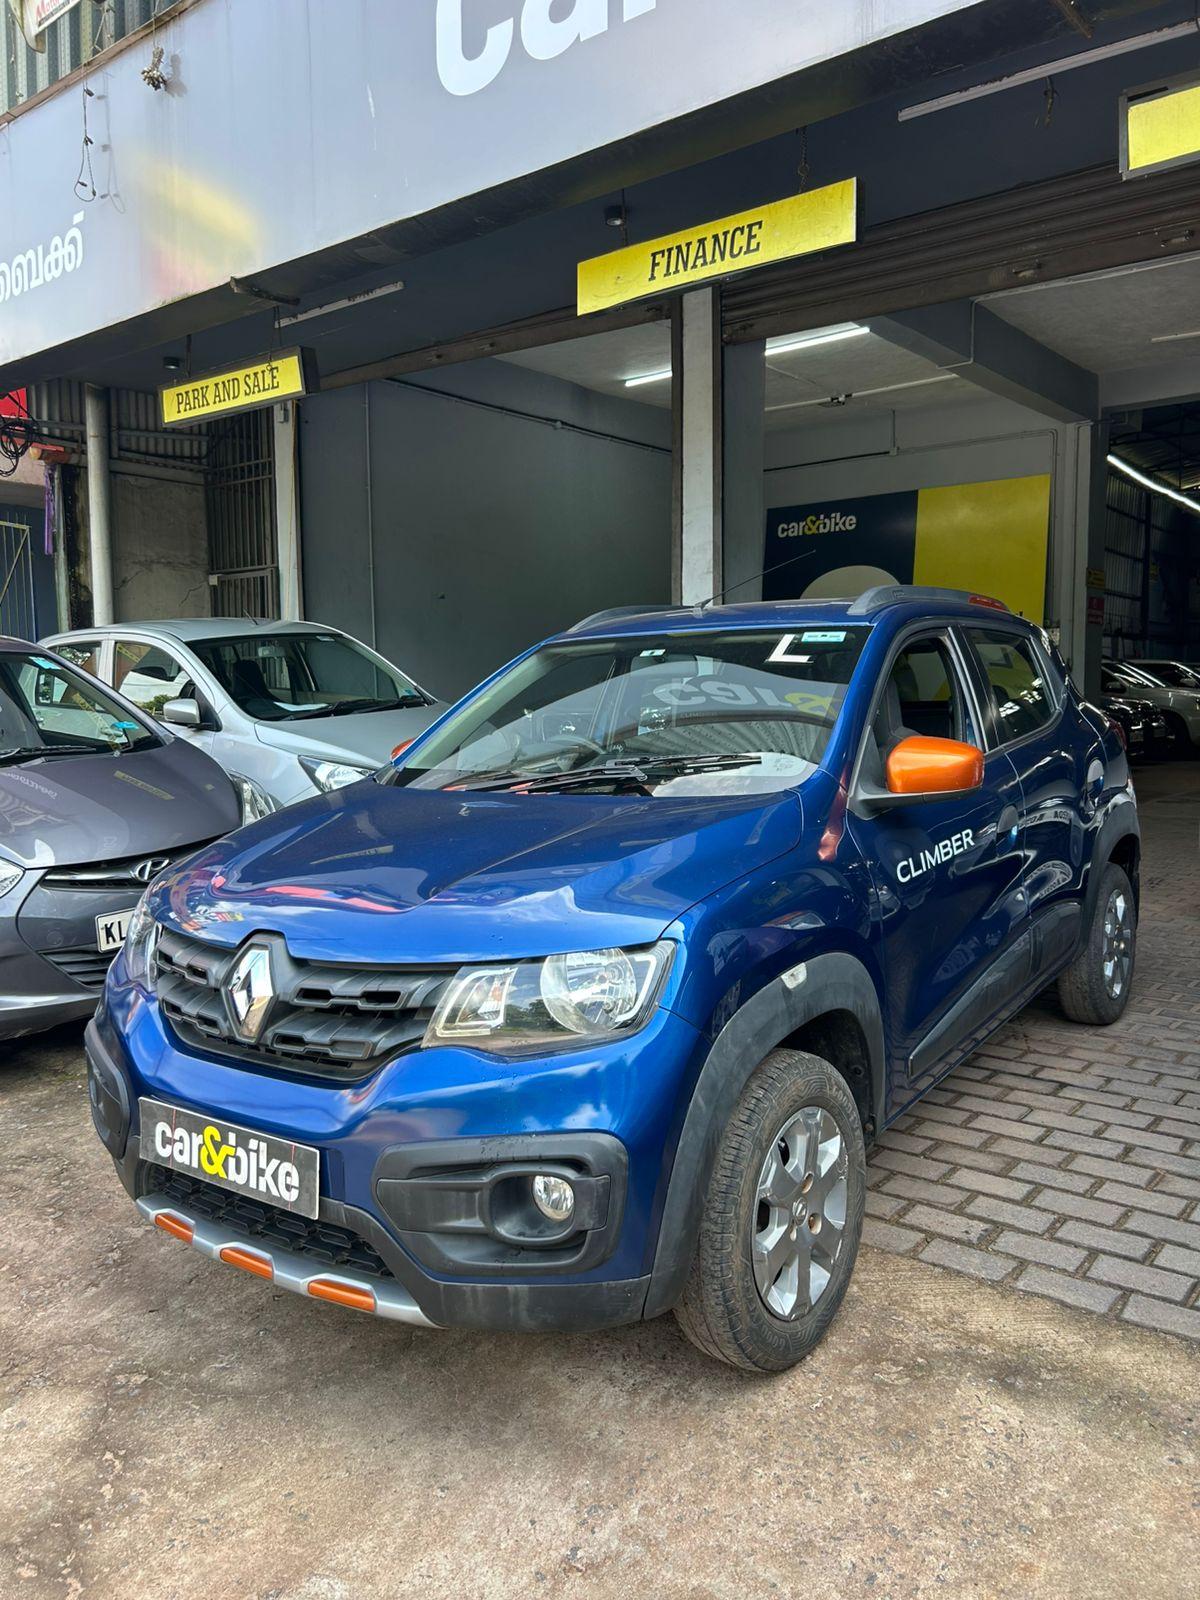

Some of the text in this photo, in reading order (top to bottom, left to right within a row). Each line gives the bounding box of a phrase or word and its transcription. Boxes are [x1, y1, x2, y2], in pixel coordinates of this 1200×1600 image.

[648, 220, 764, 282] FINANCE
[175, 366, 280, 414] PARK AND SALE
[777, 512, 857, 538] car&bike
[896, 828, 976, 883] CLIMBER
[104, 920, 127, 945] KL
[155, 1121, 300, 1202] car&bike
